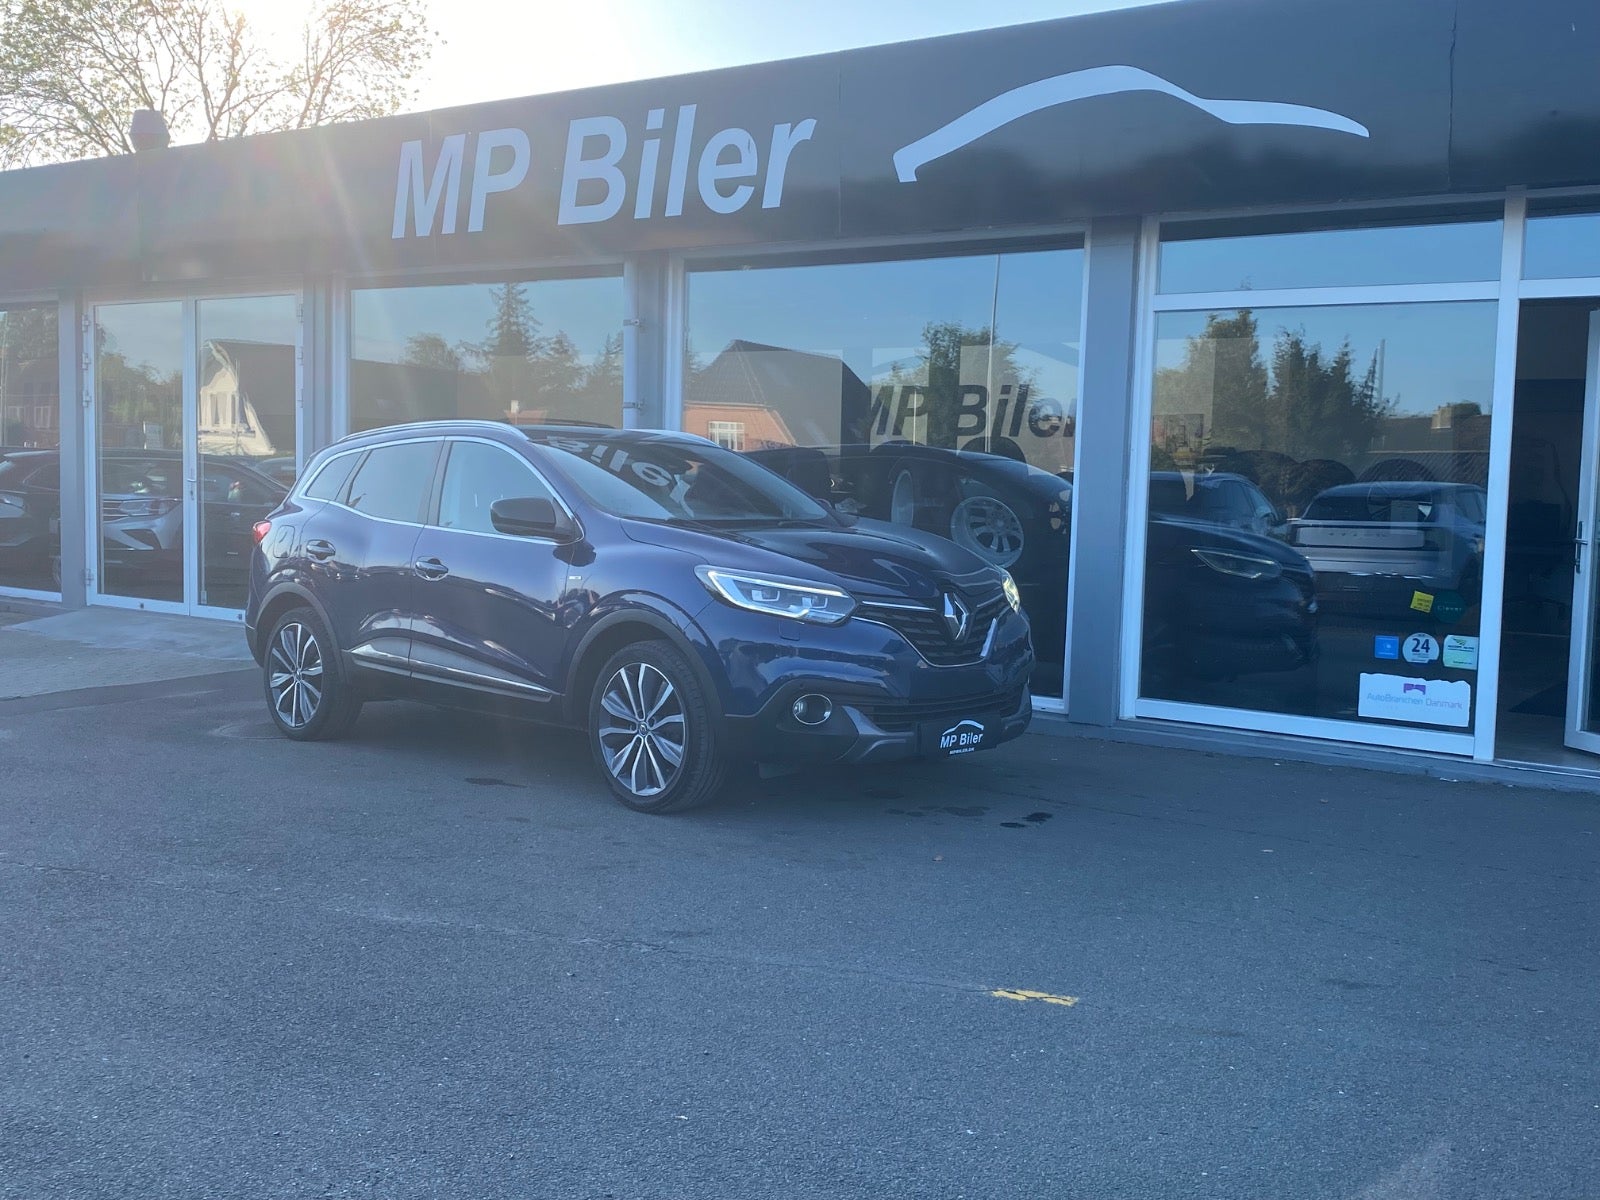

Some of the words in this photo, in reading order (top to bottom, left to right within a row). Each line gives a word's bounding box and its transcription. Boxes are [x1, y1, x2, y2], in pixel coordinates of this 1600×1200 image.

[391, 127, 531, 239] MP
[557, 103, 817, 225] Biler
[1411, 637, 1431, 653] 24
[1425, 698, 1463, 710] Danmark
[940, 735, 957, 748] MP
[959, 732, 983, 745] Biler
